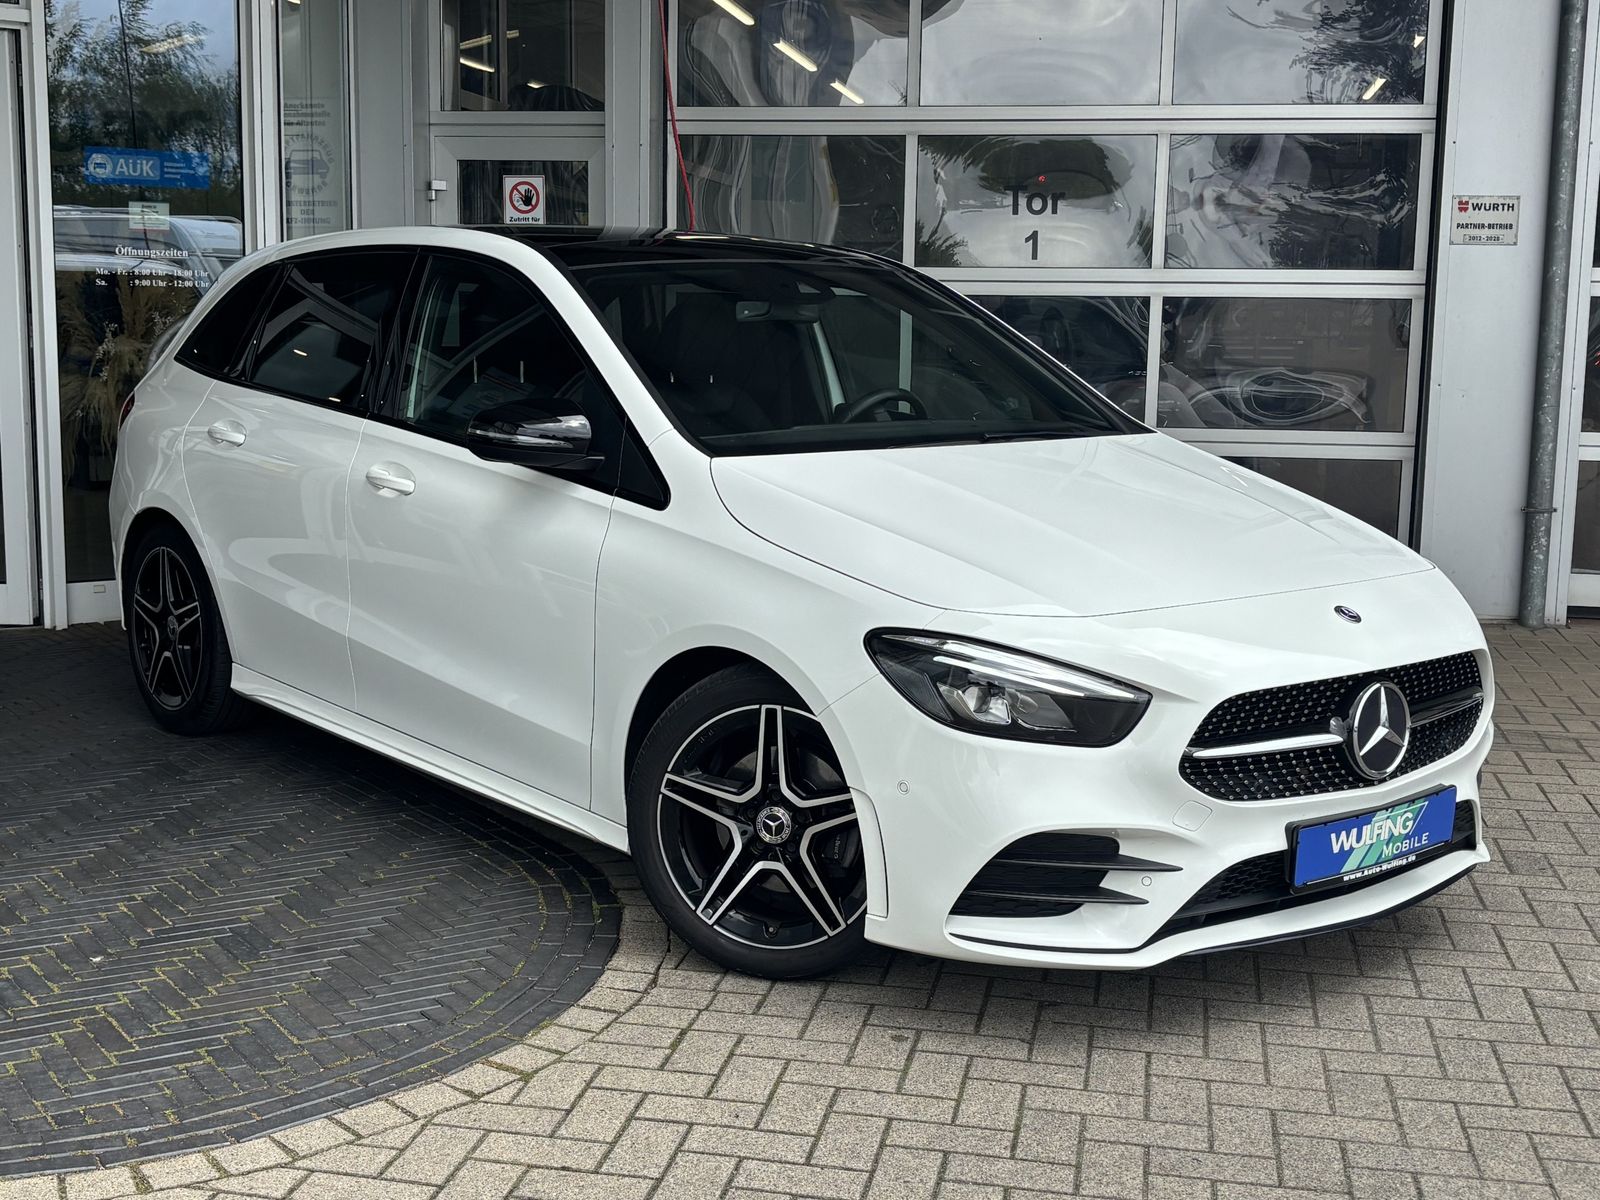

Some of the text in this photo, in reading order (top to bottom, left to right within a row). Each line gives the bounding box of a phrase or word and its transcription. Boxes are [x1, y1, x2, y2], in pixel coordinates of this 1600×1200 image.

[1004, 185, 1066, 215] Tor
[1456, 222, 1514, 230] PARTNER-BETRIEB
[115, 244, 189, 258] Öffnungszeiten
[1024, 229, 1039, 261] 1
[95, 267, 111, 275] Mo.
[117, 267, 128, 276] Fr.
[134, 268, 151, 276] 8:00
[152, 268, 167, 277] Uhr
[174, 268, 193, 277] 18:00
[194, 269, 209, 278] Uhr
[95, 278, 108, 286] Sa.
[134, 279, 151, 287] 9:00
[152, 279, 167, 287] Uhr
[173, 279, 193, 288] 12:00
[194, 279, 209, 288] Uhr
[1330, 812, 1414, 854] WULFING
[1382, 832, 1430, 858] MOBILE
